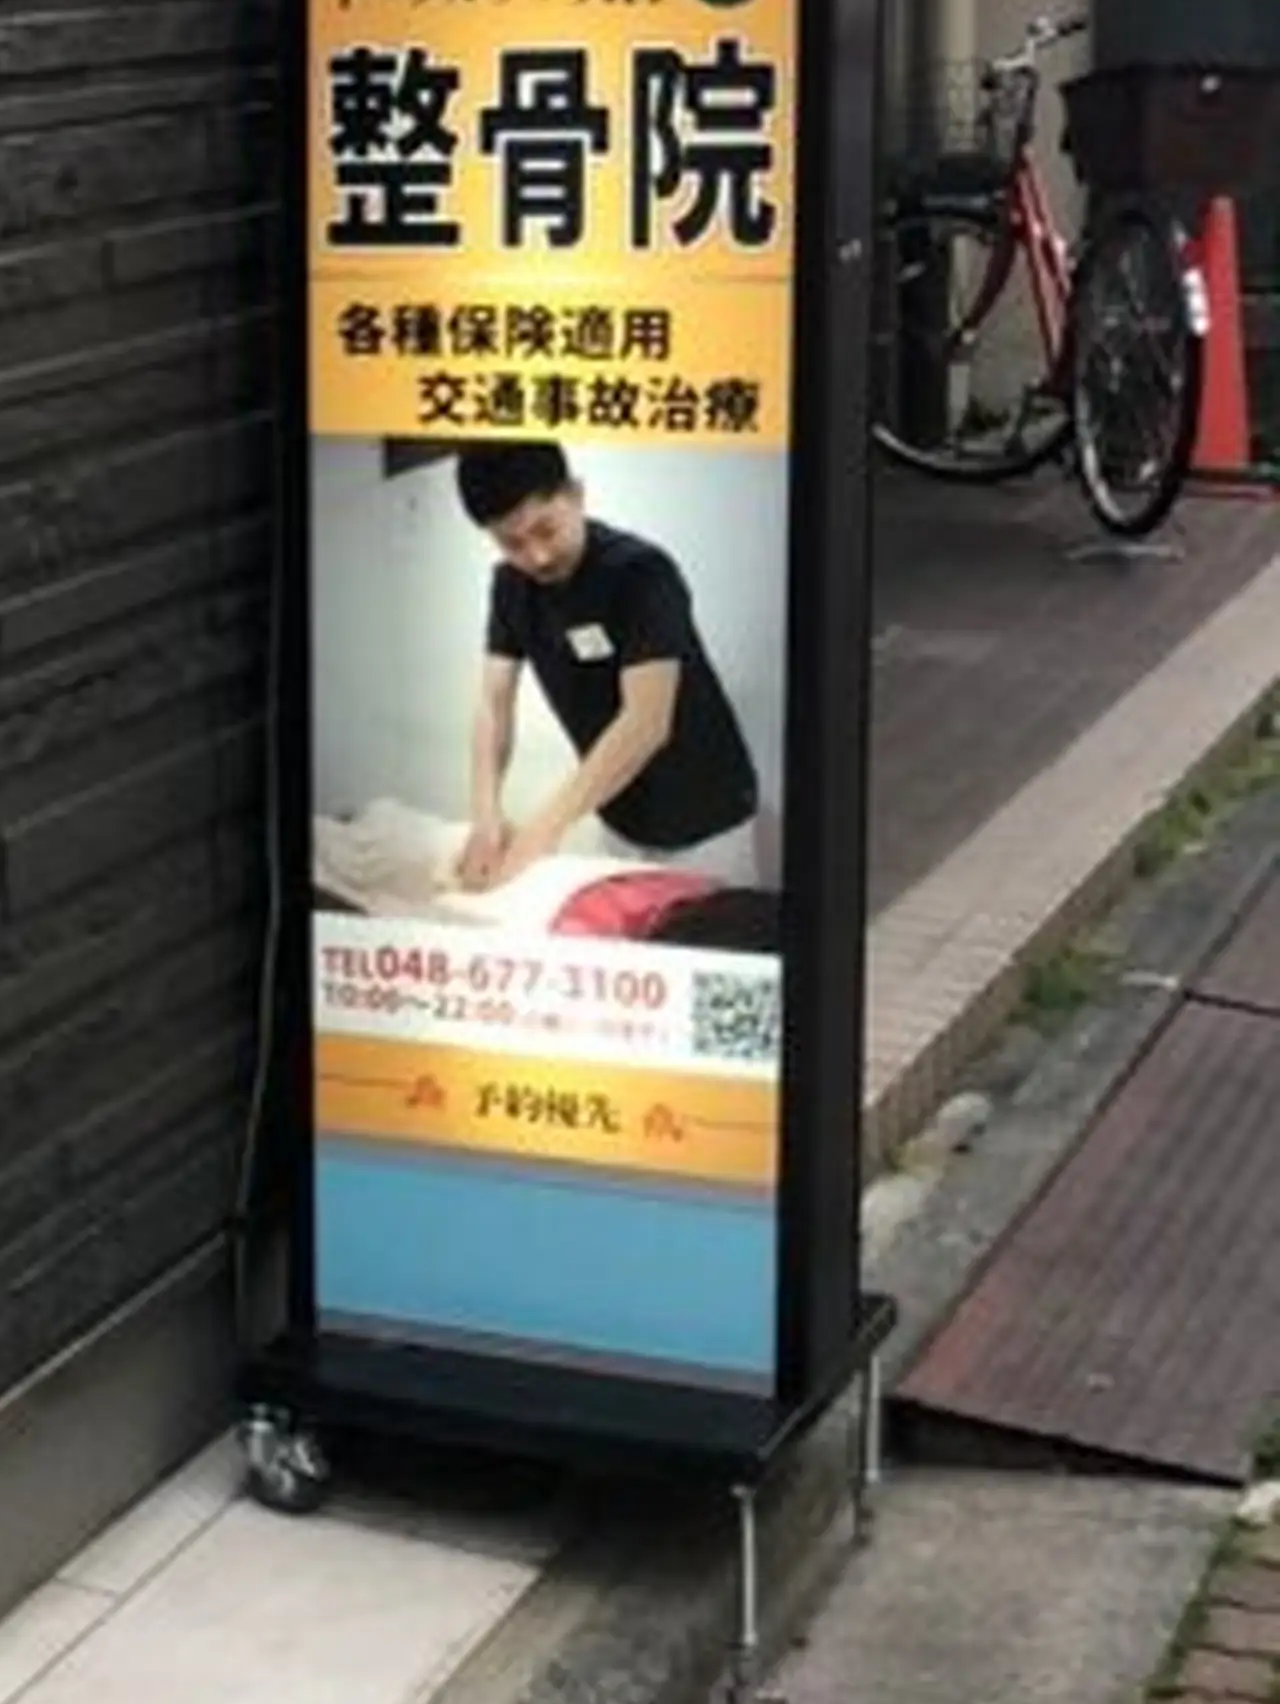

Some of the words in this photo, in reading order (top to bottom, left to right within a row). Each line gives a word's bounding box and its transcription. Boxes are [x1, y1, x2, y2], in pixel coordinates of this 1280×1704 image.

[326, 38, 778, 250] 整骨院
[338, 302, 672, 359] 各種保険適用
[418, 372, 762, 434] 交通事故治療
